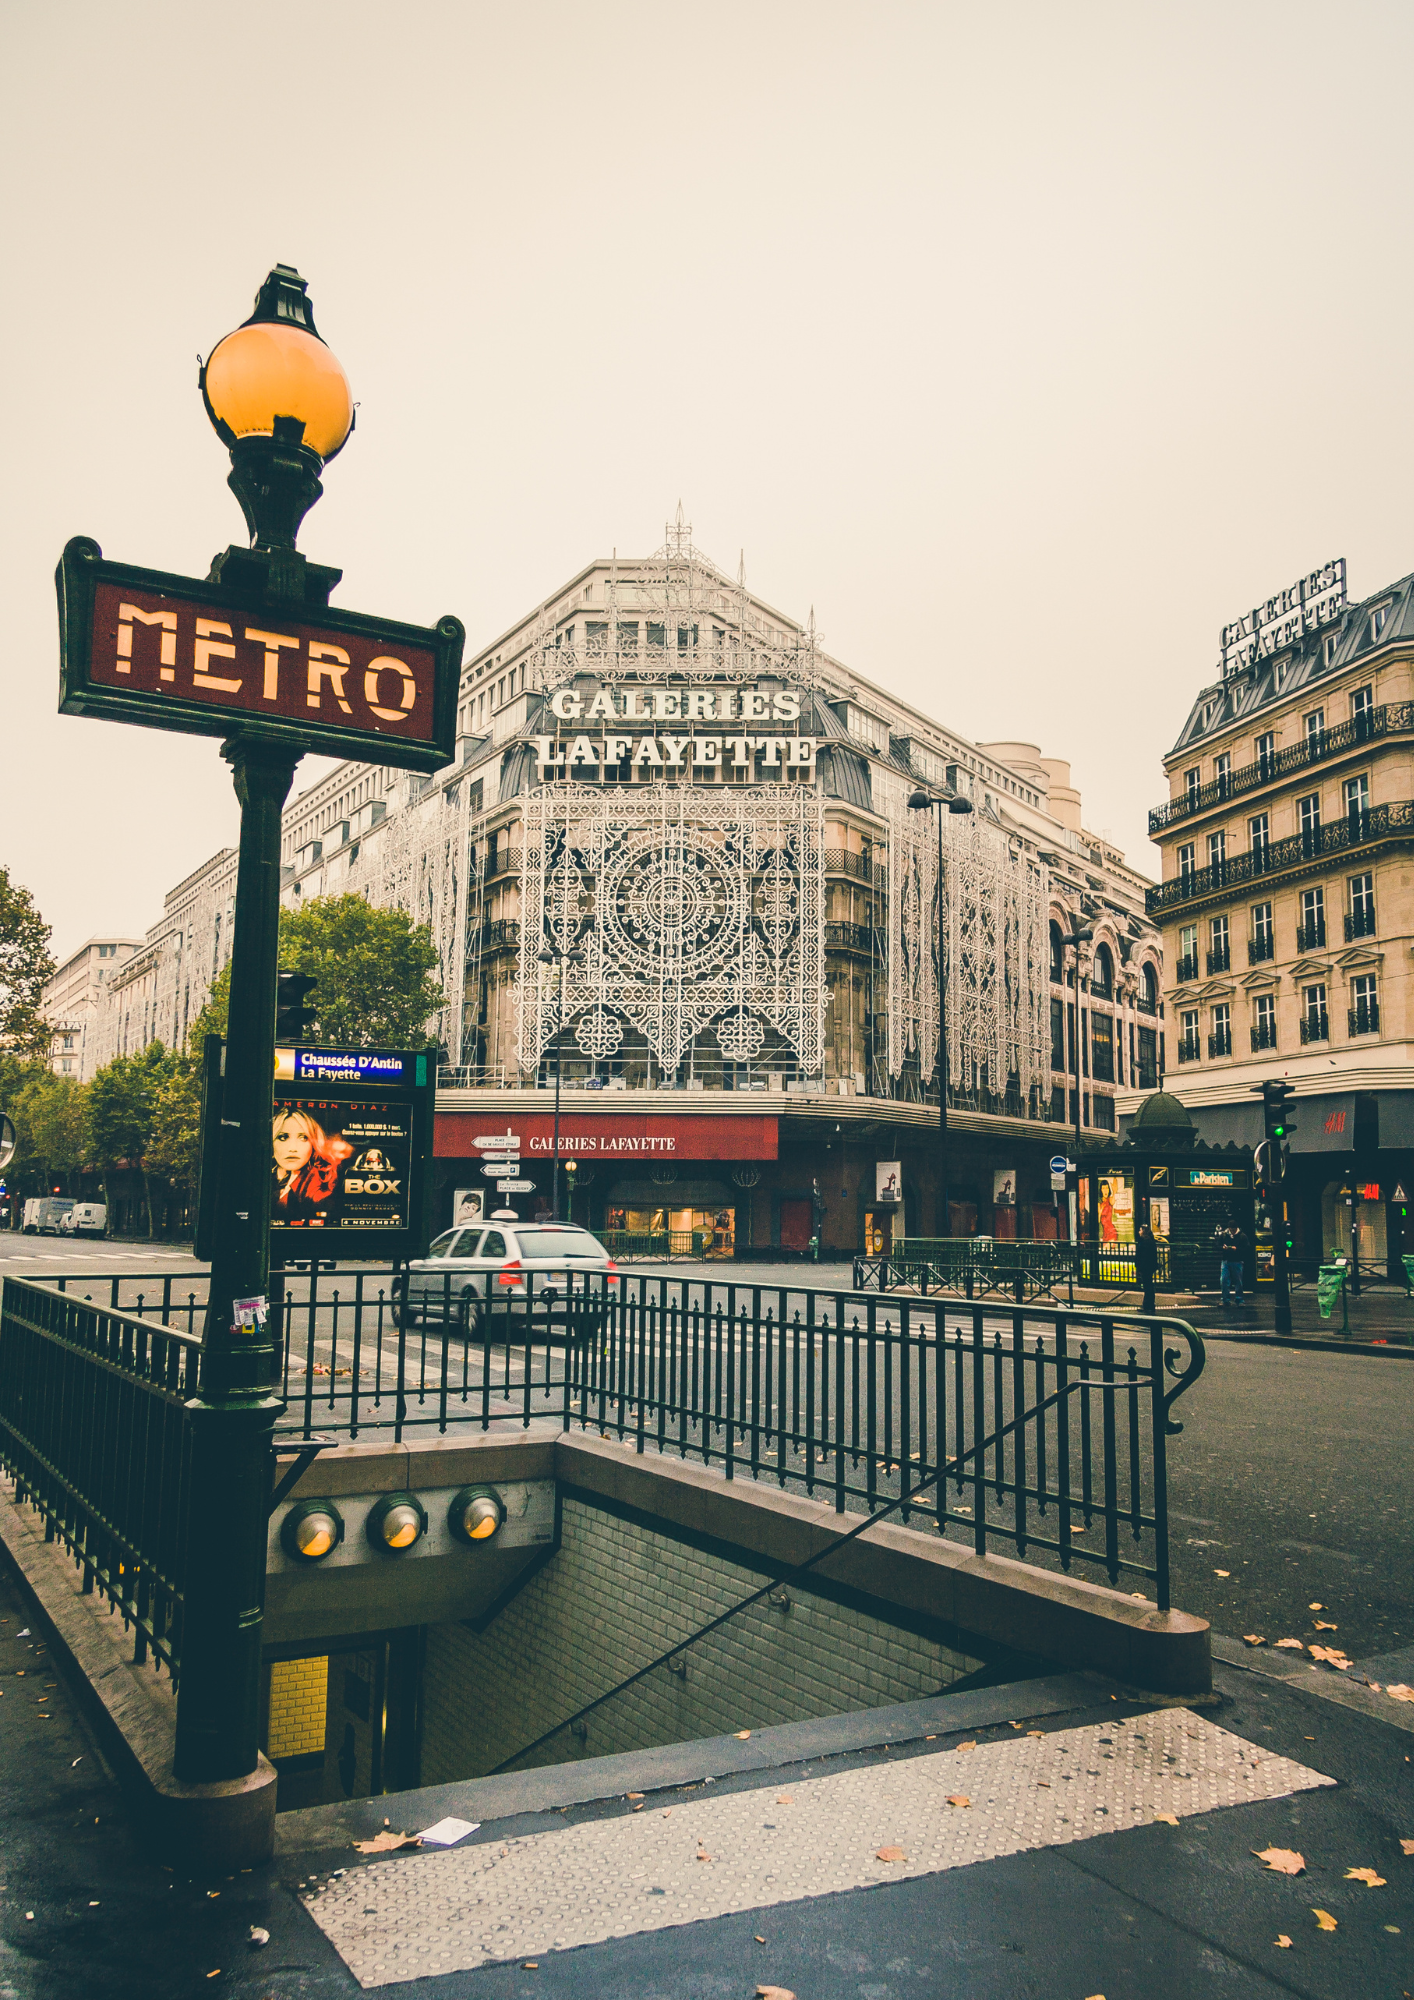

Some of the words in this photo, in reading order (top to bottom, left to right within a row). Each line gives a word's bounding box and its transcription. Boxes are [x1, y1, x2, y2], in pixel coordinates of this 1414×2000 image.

[1218, 560, 1337, 651] GALERIES
[1217, 592, 1343, 682] LAFAYETTE
[115, 602, 416, 722] METRO
[551, 690, 801, 721] GALERIES
[535, 735, 817, 767] LAFAYETTE
[301, 1053, 356, 1068] Chaussée
[358, 1056, 402, 1070] D'Antin
[301, 1067, 315, 1078] La
[318, 1067, 361, 1082] Fayette
[272, 1100, 338, 1109] AMERON
[350, 1104, 388, 1112] DIAZ
[529, 1136, 597, 1151] GALERIES
[600, 1136, 676, 1151] LAFAYETTE
[344, 1178, 402, 1195] BOX
